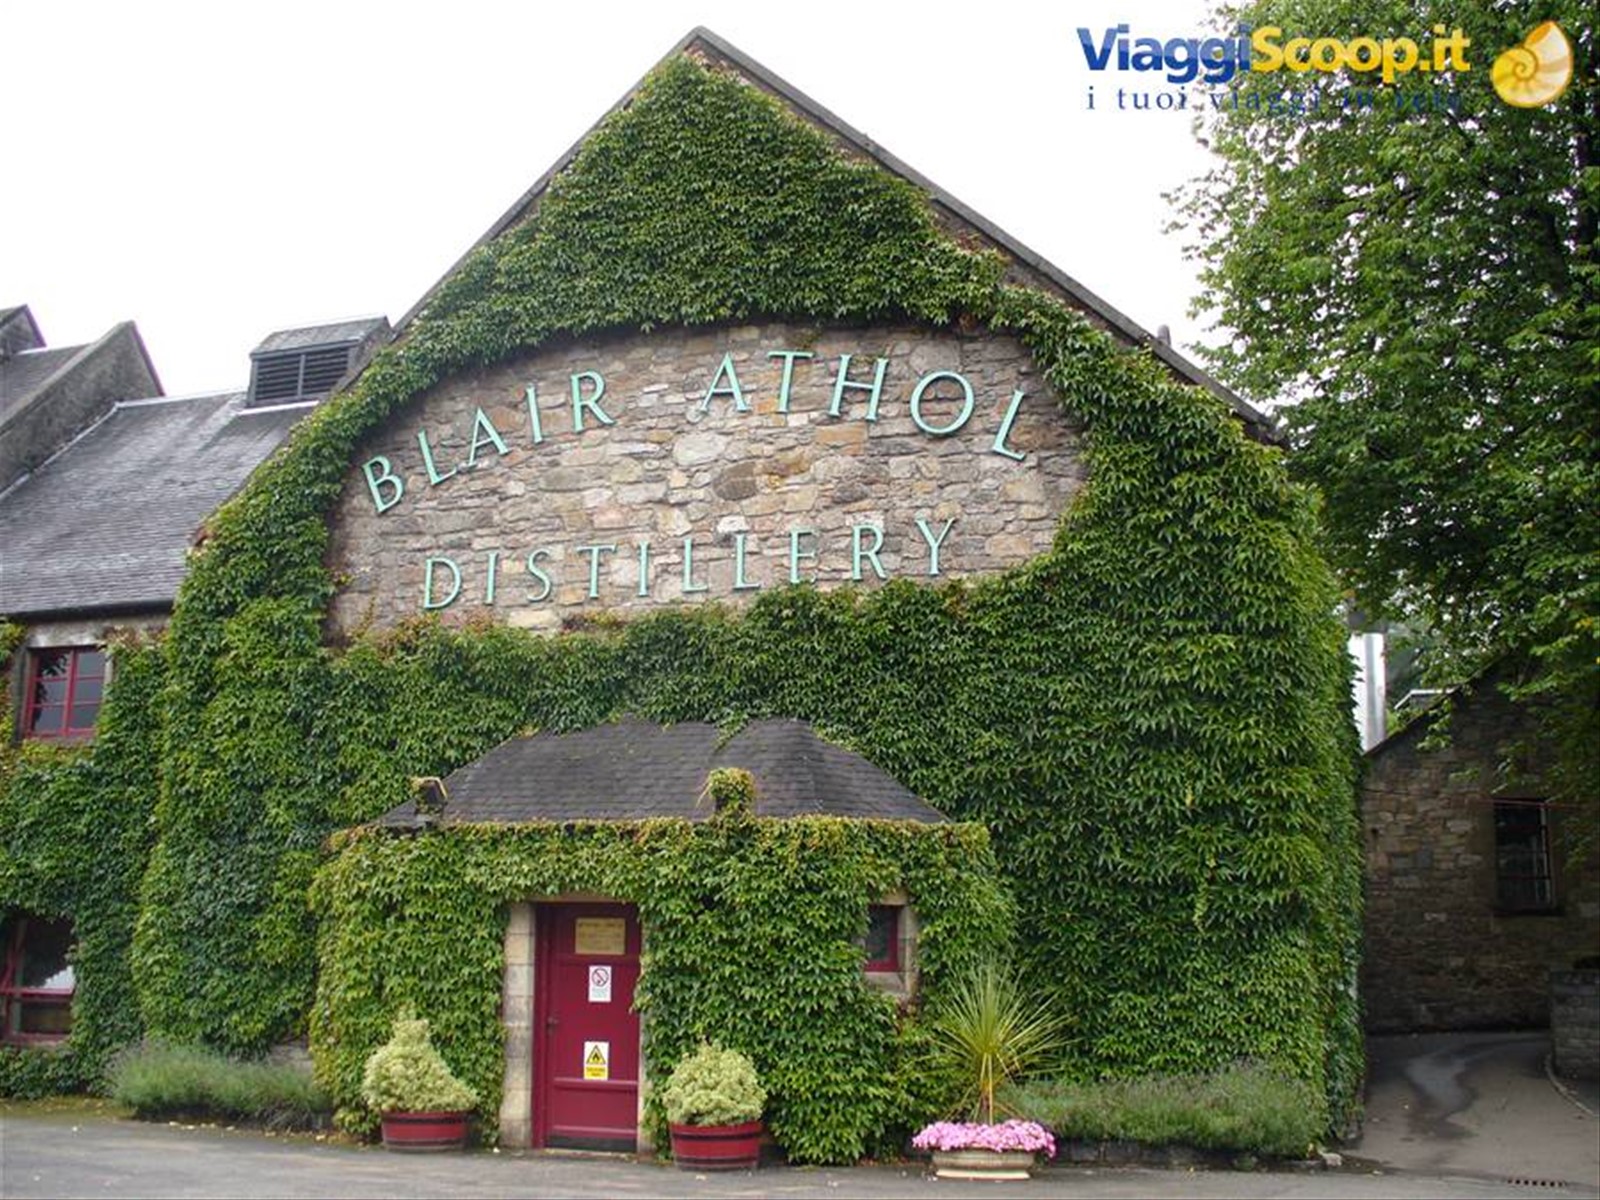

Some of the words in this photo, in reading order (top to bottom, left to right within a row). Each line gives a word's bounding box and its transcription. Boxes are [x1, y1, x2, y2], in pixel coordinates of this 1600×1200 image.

[362, 370, 617, 513] BLAIR
[700, 350, 1026, 461] ATHOL
[424, 518, 955, 609] DISTILLERY
